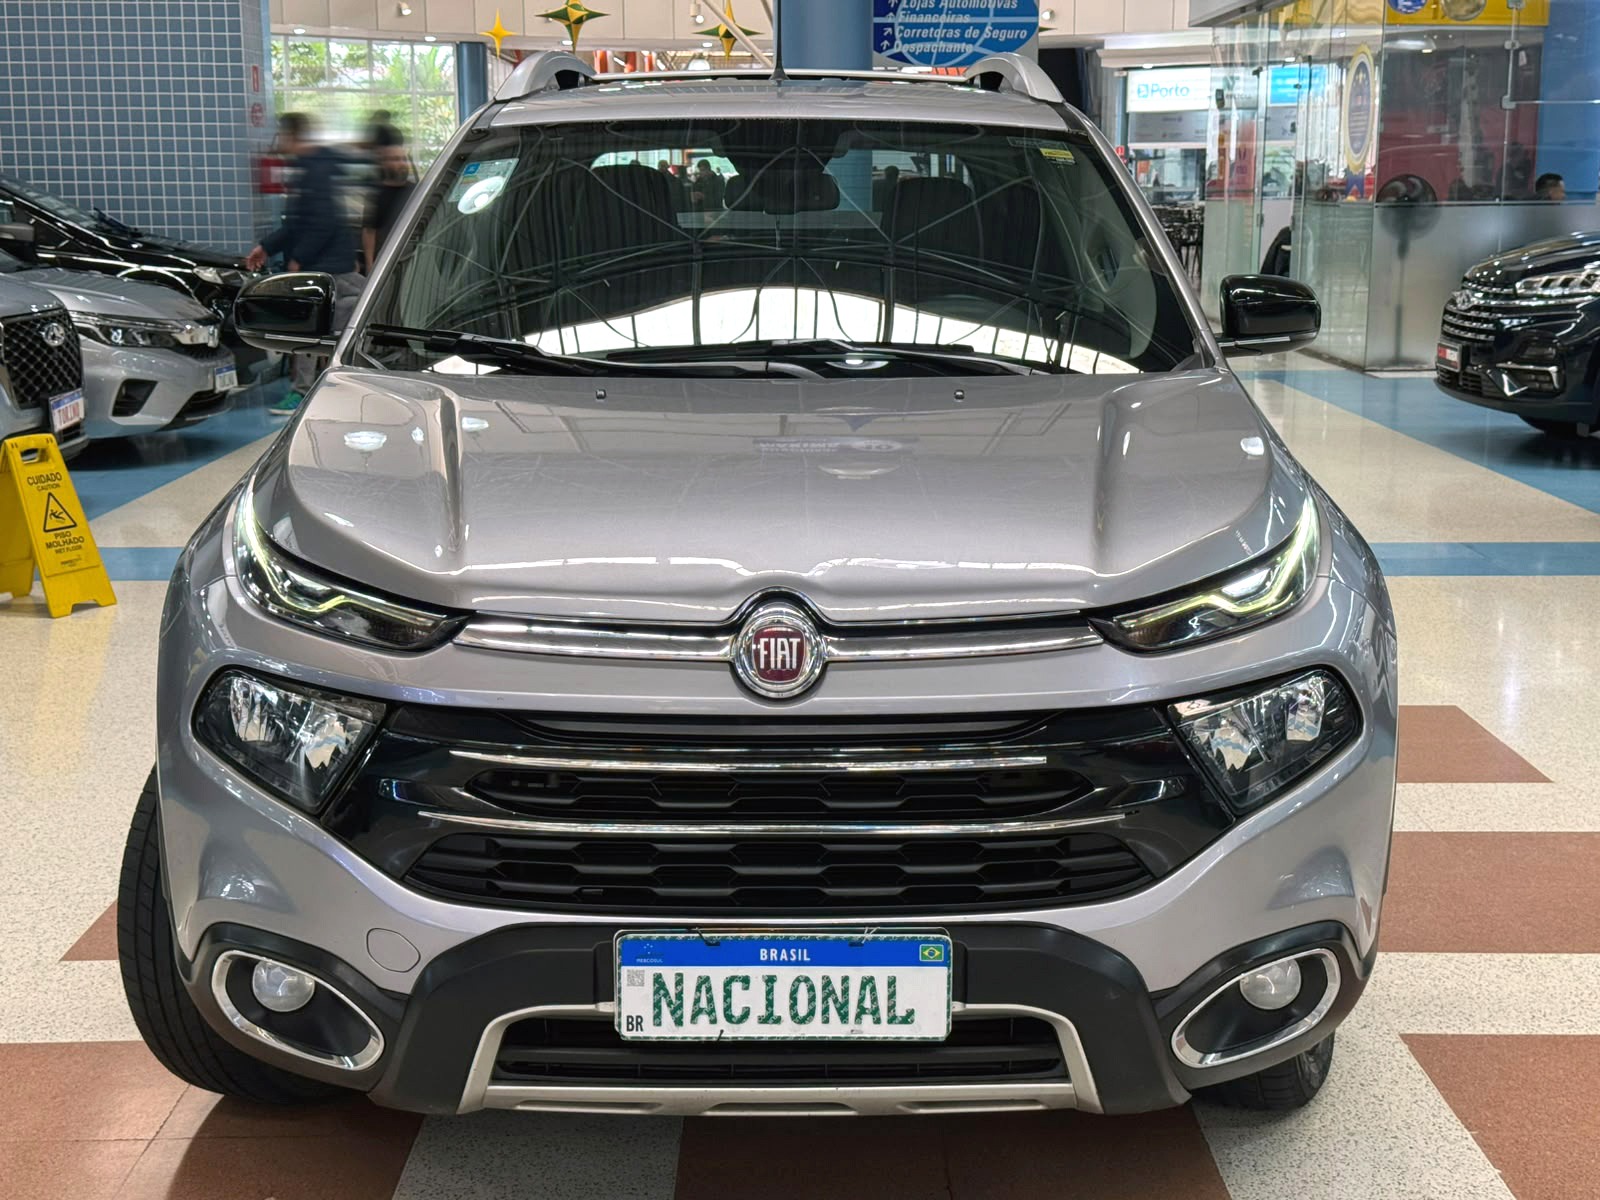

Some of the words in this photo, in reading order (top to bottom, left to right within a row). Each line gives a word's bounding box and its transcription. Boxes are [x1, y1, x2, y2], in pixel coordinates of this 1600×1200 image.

[902, 0, 935, 10] Lojas
[899, 11, 971, 23] Financeiras
[897, 26, 961, 38] Corretoras
[964, 26, 980, 38] de
[984, 26, 1028, 41] Seguro
[894, 40, 974, 55] Despachante
[1151, 83, 1190, 98] Porto
[27, 471, 63, 486] CUIDADO
[45, 535, 85, 550] MOLHADO
[54, 530, 72, 540] PISO
[760, 637, 801, 669] FIAT
[759, 948, 811, 962] BRASIL
[652, 972, 916, 1028] NACIONAL
[626, 1015, 644, 1032] BR
